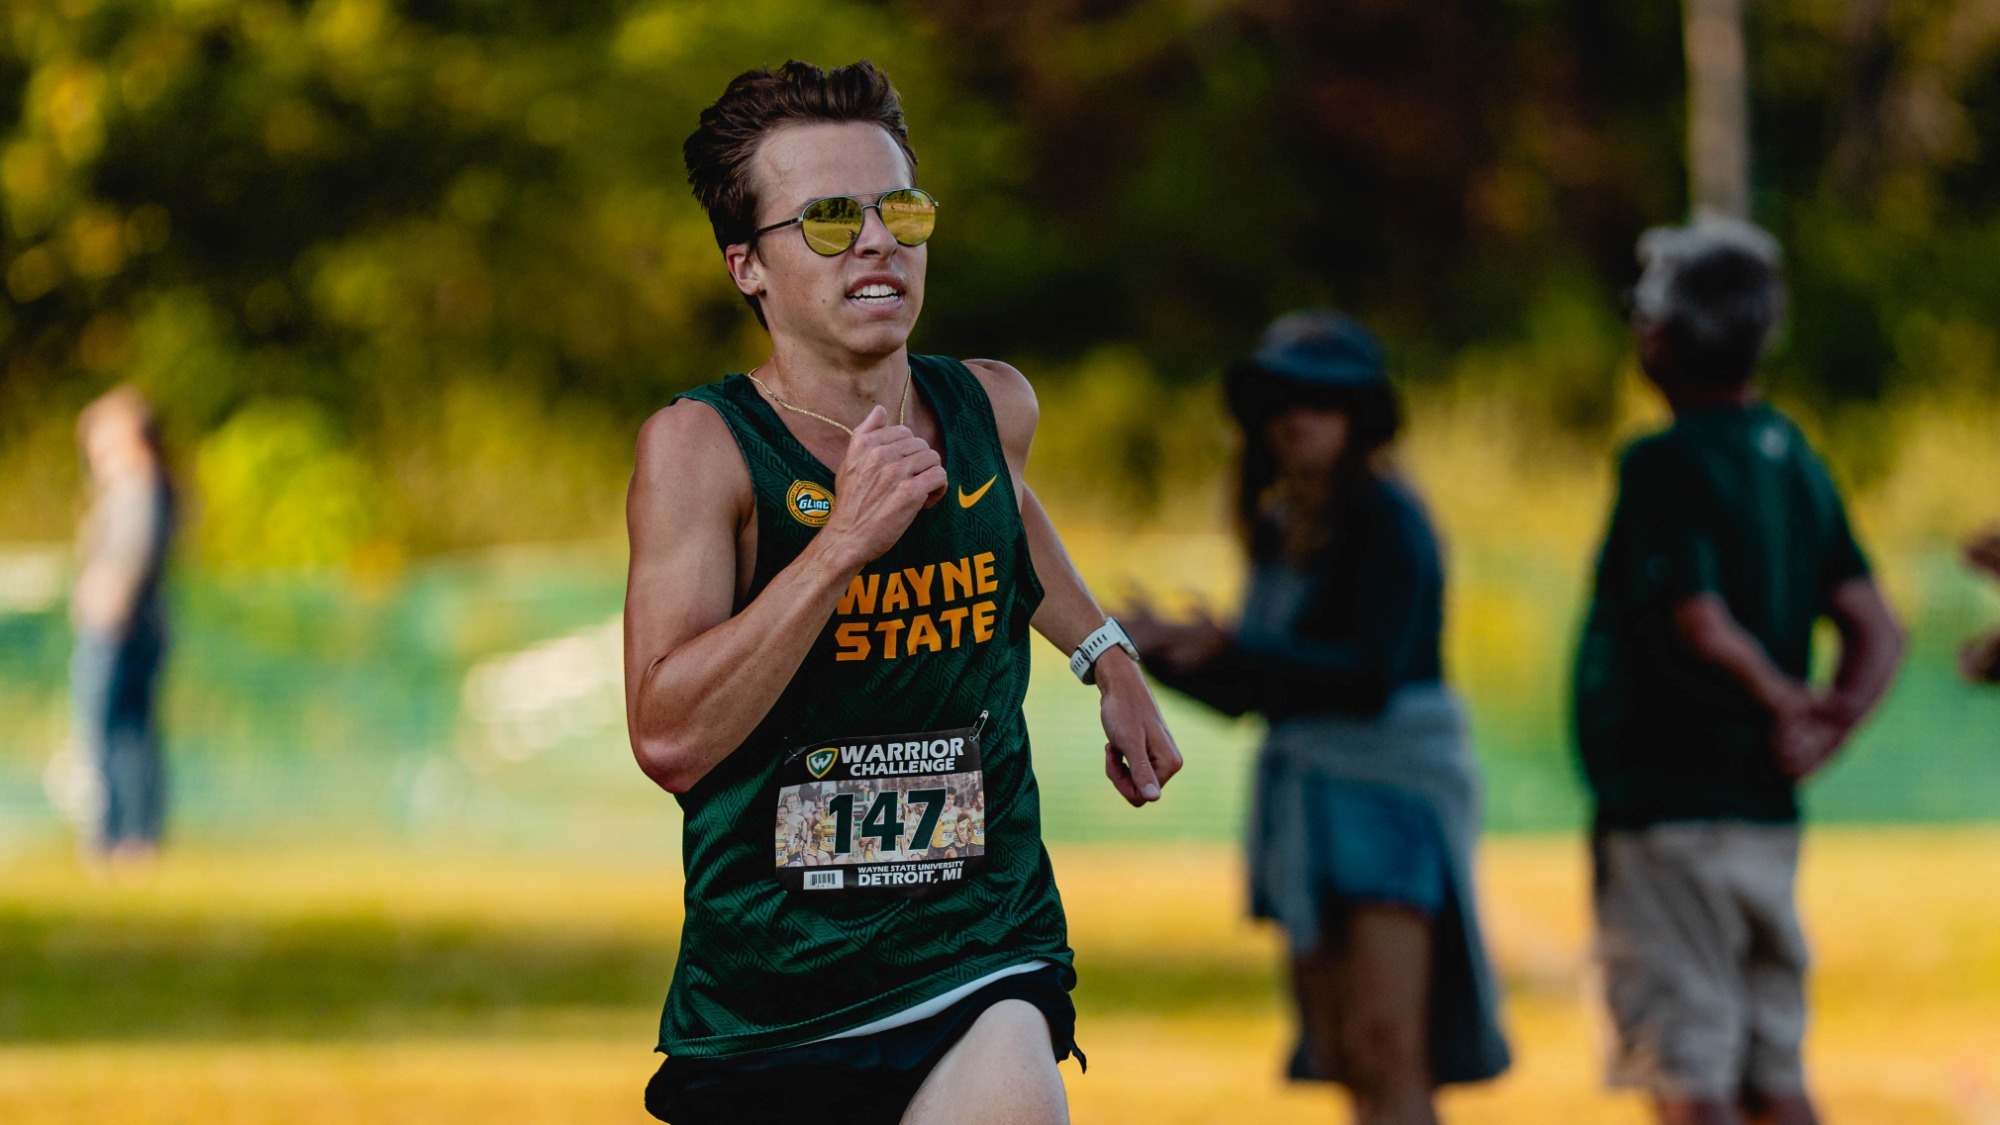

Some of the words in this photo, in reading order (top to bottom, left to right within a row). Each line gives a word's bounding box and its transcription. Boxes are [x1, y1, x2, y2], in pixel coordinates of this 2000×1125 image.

[799, 499, 830, 509] GLIAC
[836, 551, 998, 615] WAYNE
[834, 600, 997, 661] STATE
[840, 737, 964, 764] WARRIOR
[850, 757, 955, 776] CHALLENGE
[829, 788, 947, 854] 147
[858, 870, 939, 887] DETROIT,
[942, 867, 962, 880] MI
[890, 864, 916, 872] STATE
[918, 860, 964, 870] UNIVERSITY
